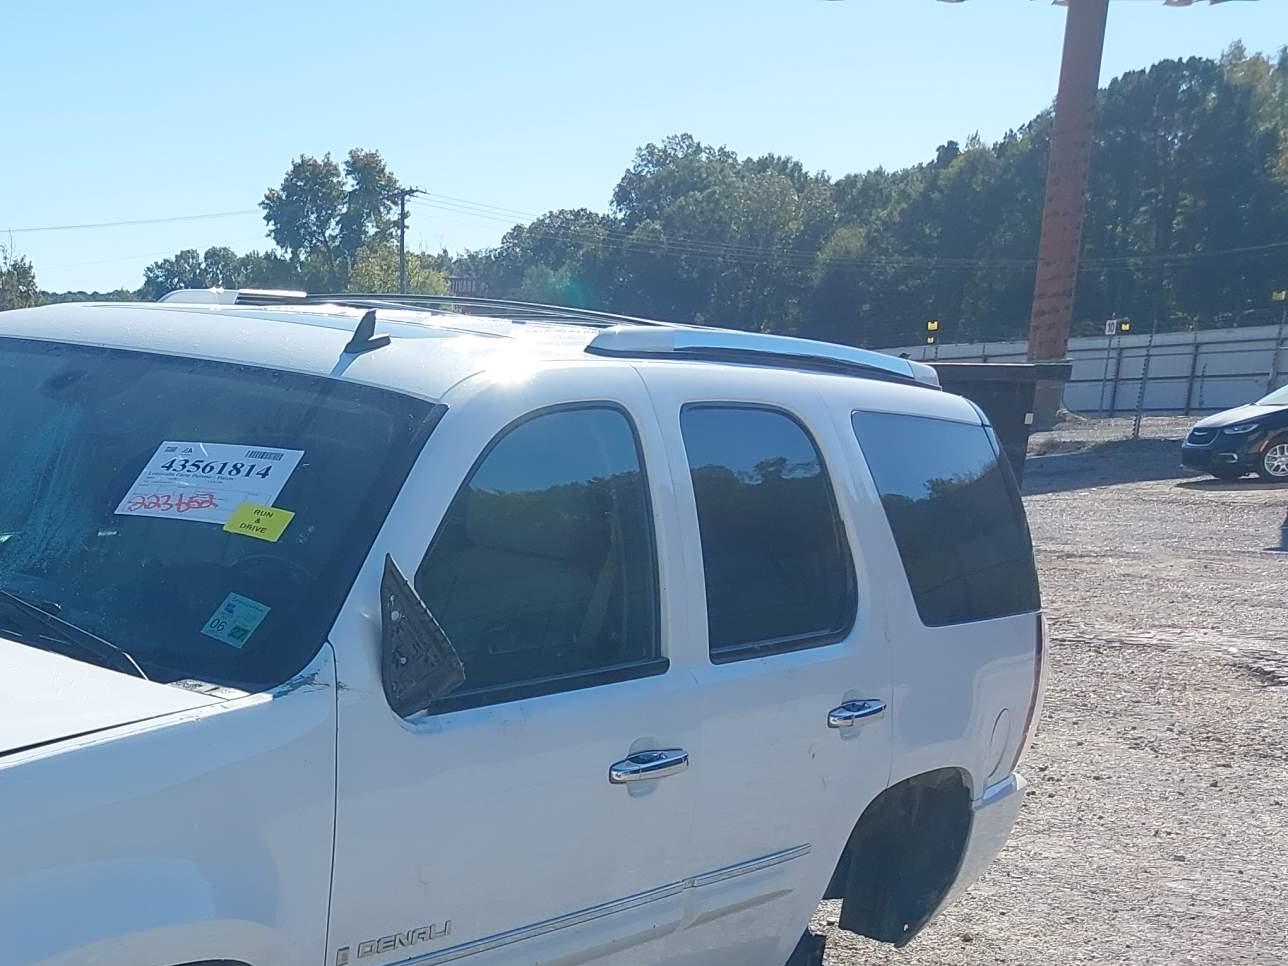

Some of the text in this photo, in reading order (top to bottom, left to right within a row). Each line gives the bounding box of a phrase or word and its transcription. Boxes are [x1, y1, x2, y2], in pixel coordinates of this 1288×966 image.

[161, 457, 273, 480] 43561814
[253, 509, 274, 519] RUN
[239, 522, 268, 534] DRIVE
[357, 920, 452, 958] DENALI
